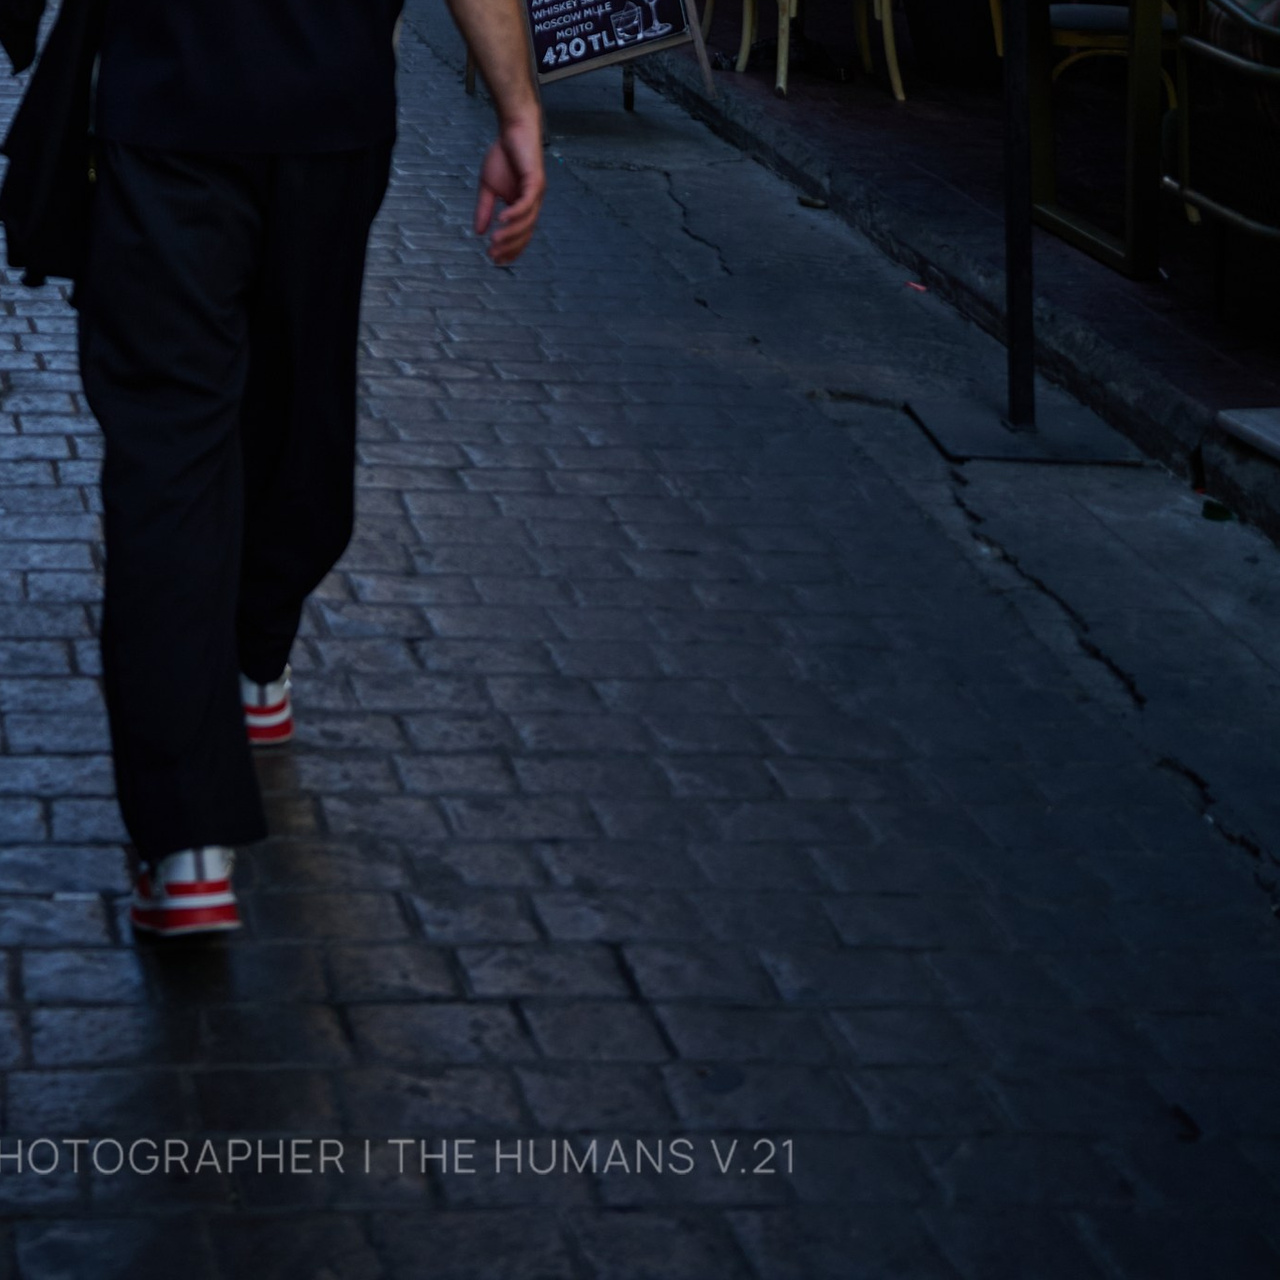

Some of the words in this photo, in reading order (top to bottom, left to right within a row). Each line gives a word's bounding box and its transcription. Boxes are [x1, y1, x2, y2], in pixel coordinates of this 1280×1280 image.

[535, 11, 582, 32] MOSCOW
[583, 2, 612, 18] MULE
[556, 22, 594, 39] MOJITO
